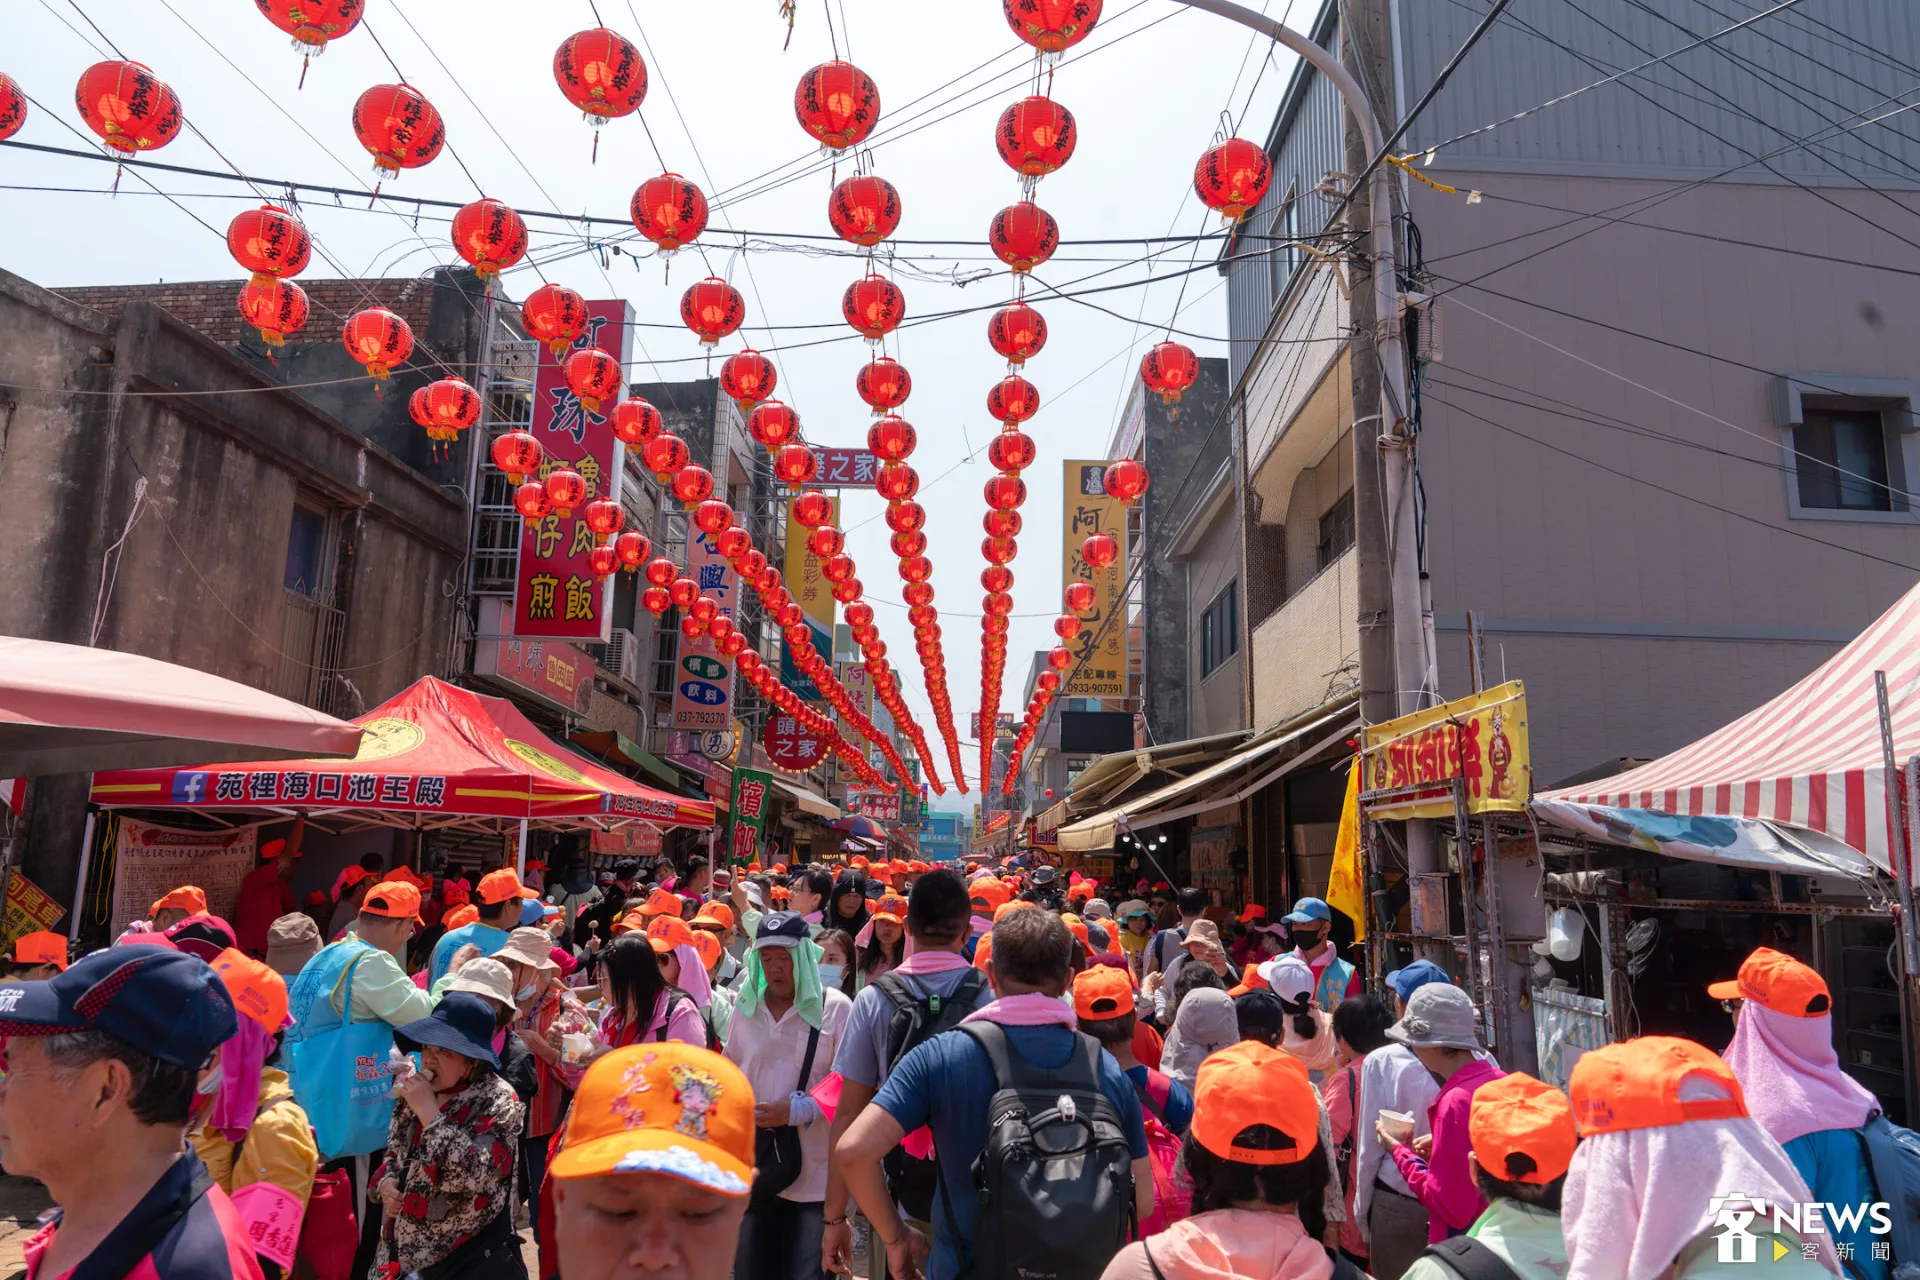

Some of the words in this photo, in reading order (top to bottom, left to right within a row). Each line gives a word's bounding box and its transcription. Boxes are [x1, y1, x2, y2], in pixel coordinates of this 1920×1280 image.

[687, 682, 721, 703] 飲料
[676, 711, 725, 724] 037-792370
[776, 739, 818, 758] 之家
[217, 771, 446, 808] 苑裡海口池王殿
[733, 777, 765, 860] 檳榔
